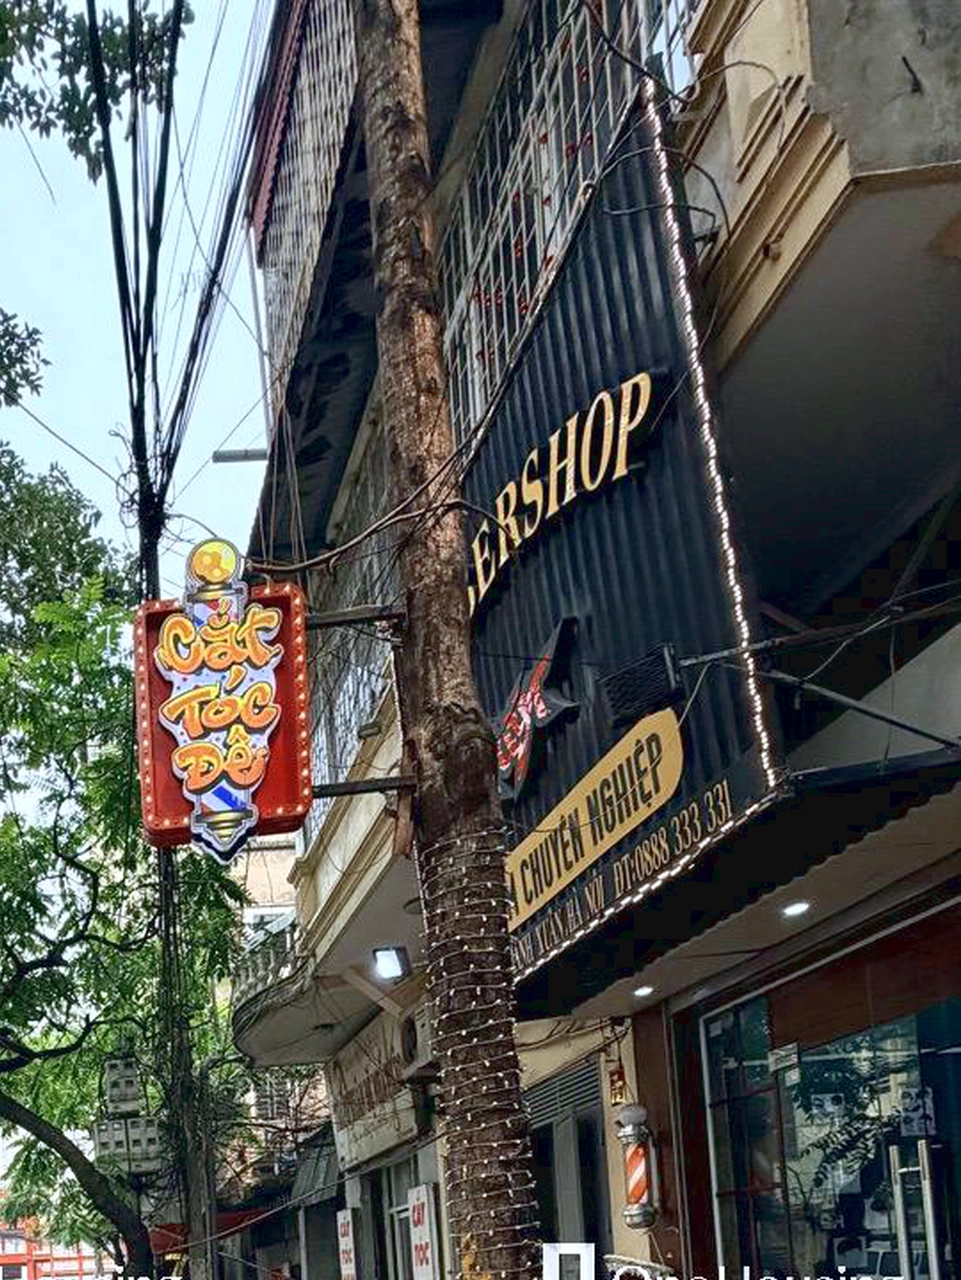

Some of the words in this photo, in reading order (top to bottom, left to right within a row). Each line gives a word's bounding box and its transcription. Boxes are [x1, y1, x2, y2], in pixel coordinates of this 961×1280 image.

[467, 371, 652, 616] ERSHOP
[156, 598, 283, 673] Cắt
[586, 732, 664, 847] NGHIỆP
[671, 803, 701, 855] 333
[704, 779, 732, 831] 331
